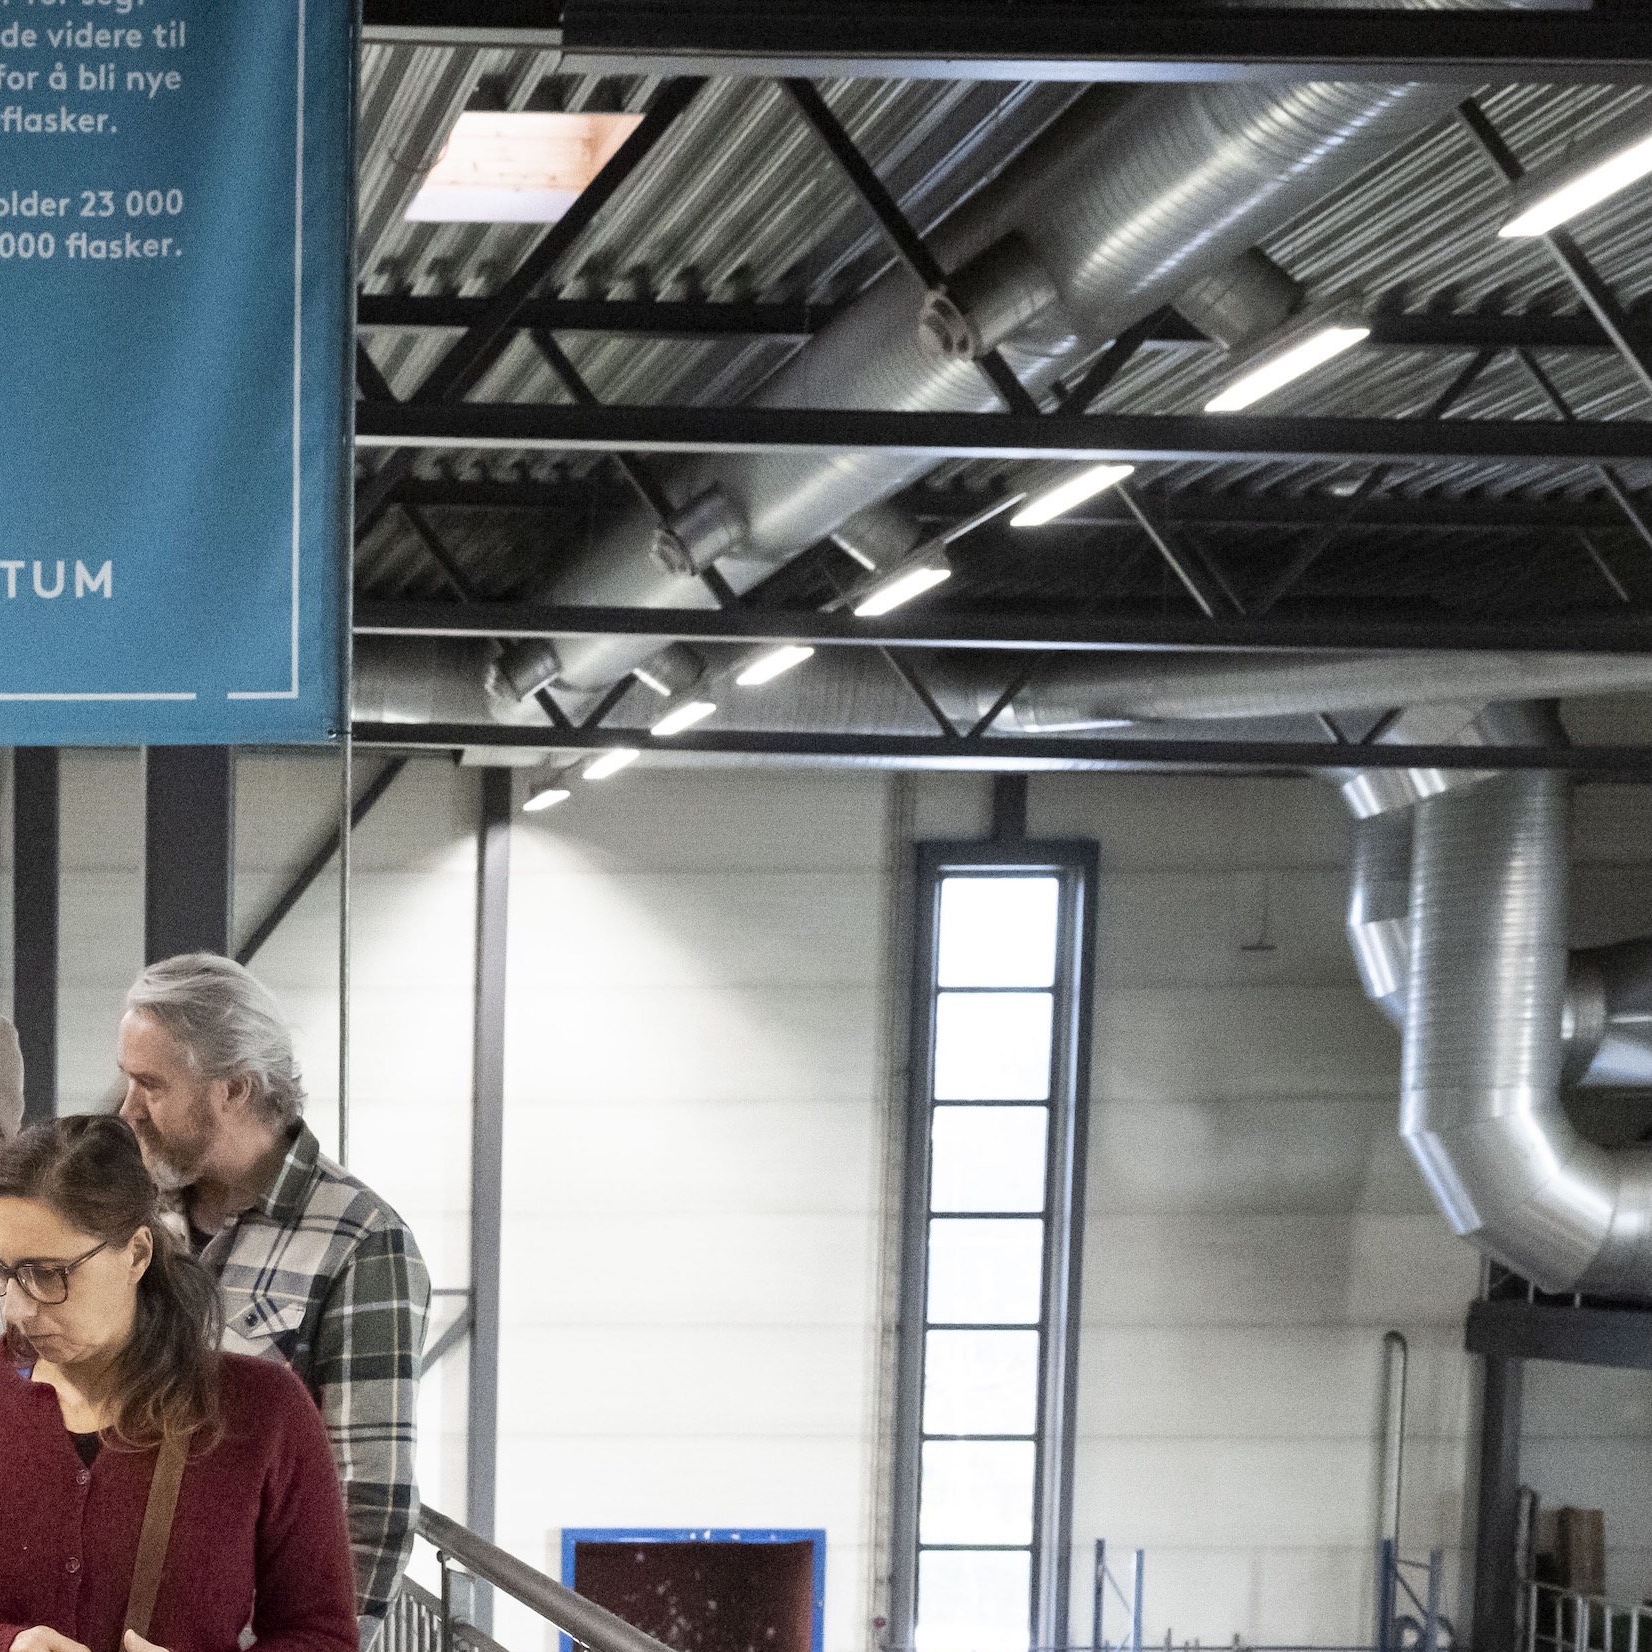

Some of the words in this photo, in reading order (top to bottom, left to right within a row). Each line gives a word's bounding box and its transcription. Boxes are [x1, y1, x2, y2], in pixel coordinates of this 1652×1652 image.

[0, 21, 37, 48] de
[48, 20, 143, 48] videre
[153, 20, 186, 48] til
[48, 63, 67, 91] å
[79, 63, 115, 91] bli
[126, 71, 182, 98] nye
[0, 105, 117, 134] flasker.
[80, 191, 114, 217] 23
[125, 189, 184, 217] 000
[65, 231, 182, 260] flasker.
